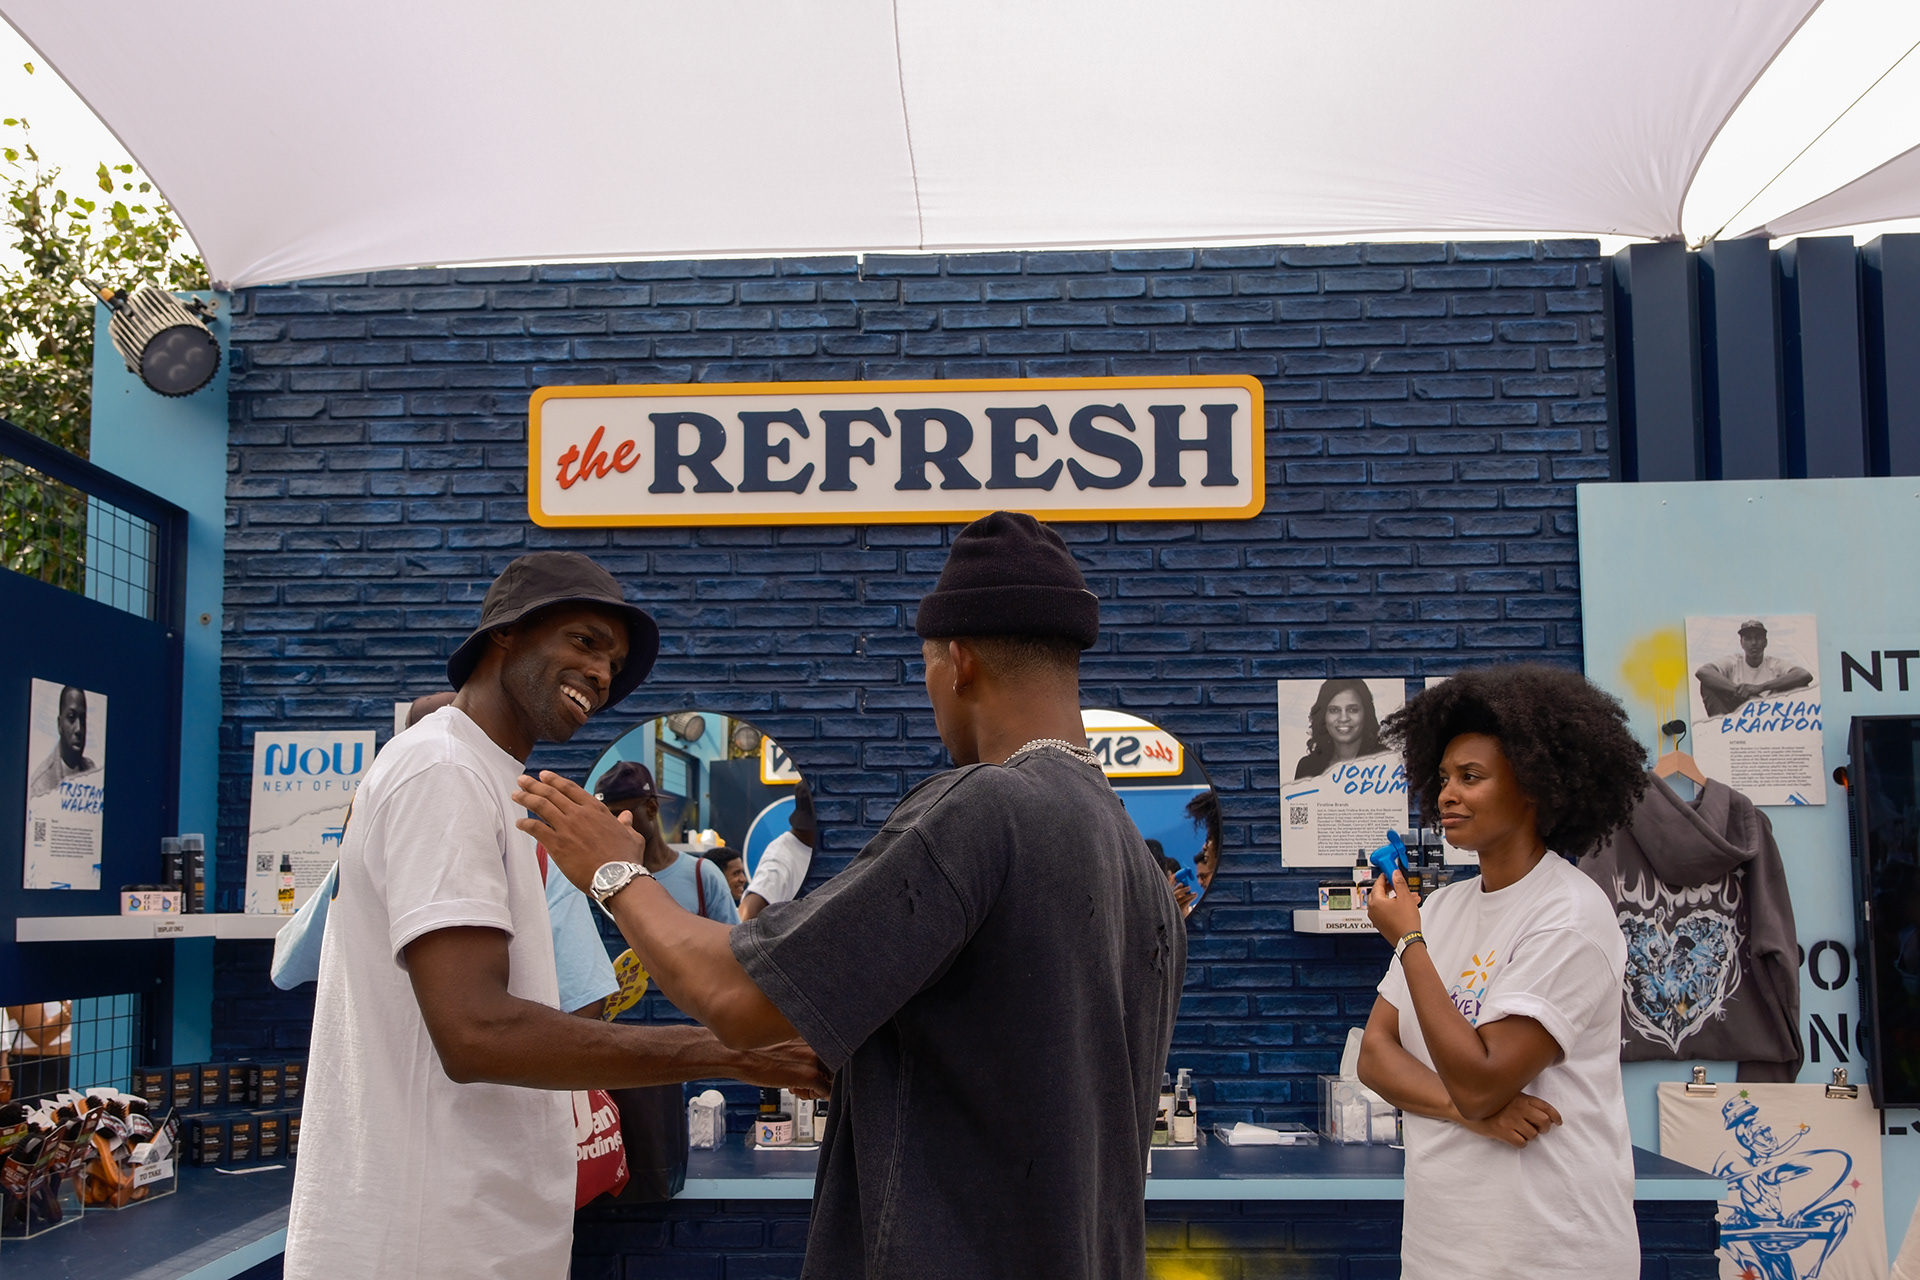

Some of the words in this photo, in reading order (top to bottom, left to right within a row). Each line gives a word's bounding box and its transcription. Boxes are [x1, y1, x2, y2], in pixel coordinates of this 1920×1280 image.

[555, 424, 641, 491] the
[647, 402, 1240, 494] REFRESH
[1742, 701, 1821, 717] ADRIAN
[1721, 716, 1823, 734] BRANDON
[1332, 764, 1387, 784] JONI
[60, 781, 104, 799] TRISTAN
[263, 780, 303, 792] NEXT
[313, 780, 332, 791] OF
[342, 780, 361, 791] US
[1344, 779, 1408, 795] ODUM
[61, 798, 104, 814] WALKER
[139, 1173, 148, 1181] TO
[148, 1169, 162, 1179] TAKE
